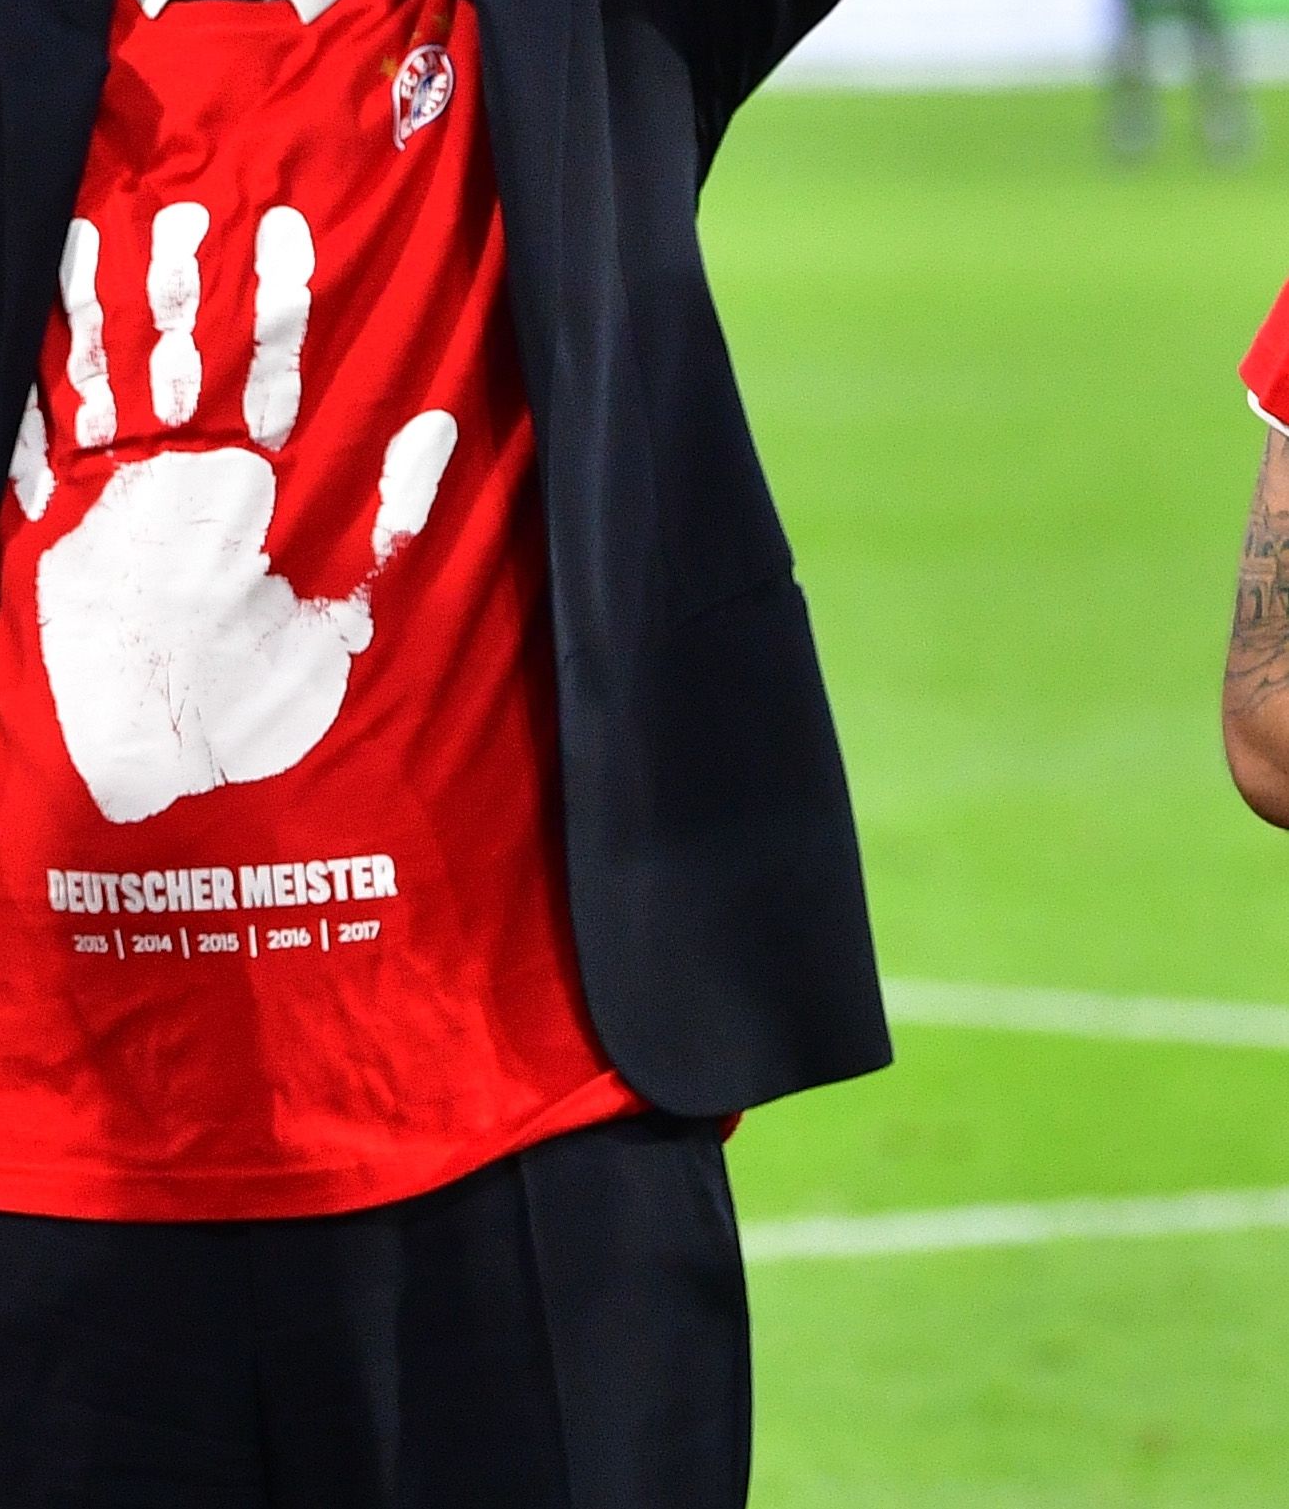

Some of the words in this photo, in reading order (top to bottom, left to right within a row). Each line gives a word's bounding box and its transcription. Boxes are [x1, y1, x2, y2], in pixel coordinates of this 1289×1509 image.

[47, 866, 238, 914] DEUTSCHER
[238, 854, 398, 909] MEISTER
[73, 934, 109, 954] 2013
[132, 934, 173, 954] 2014
[197, 933, 239, 953] 2015
[266, 928, 311, 951] 2016
[338, 920, 381, 942] 2017
